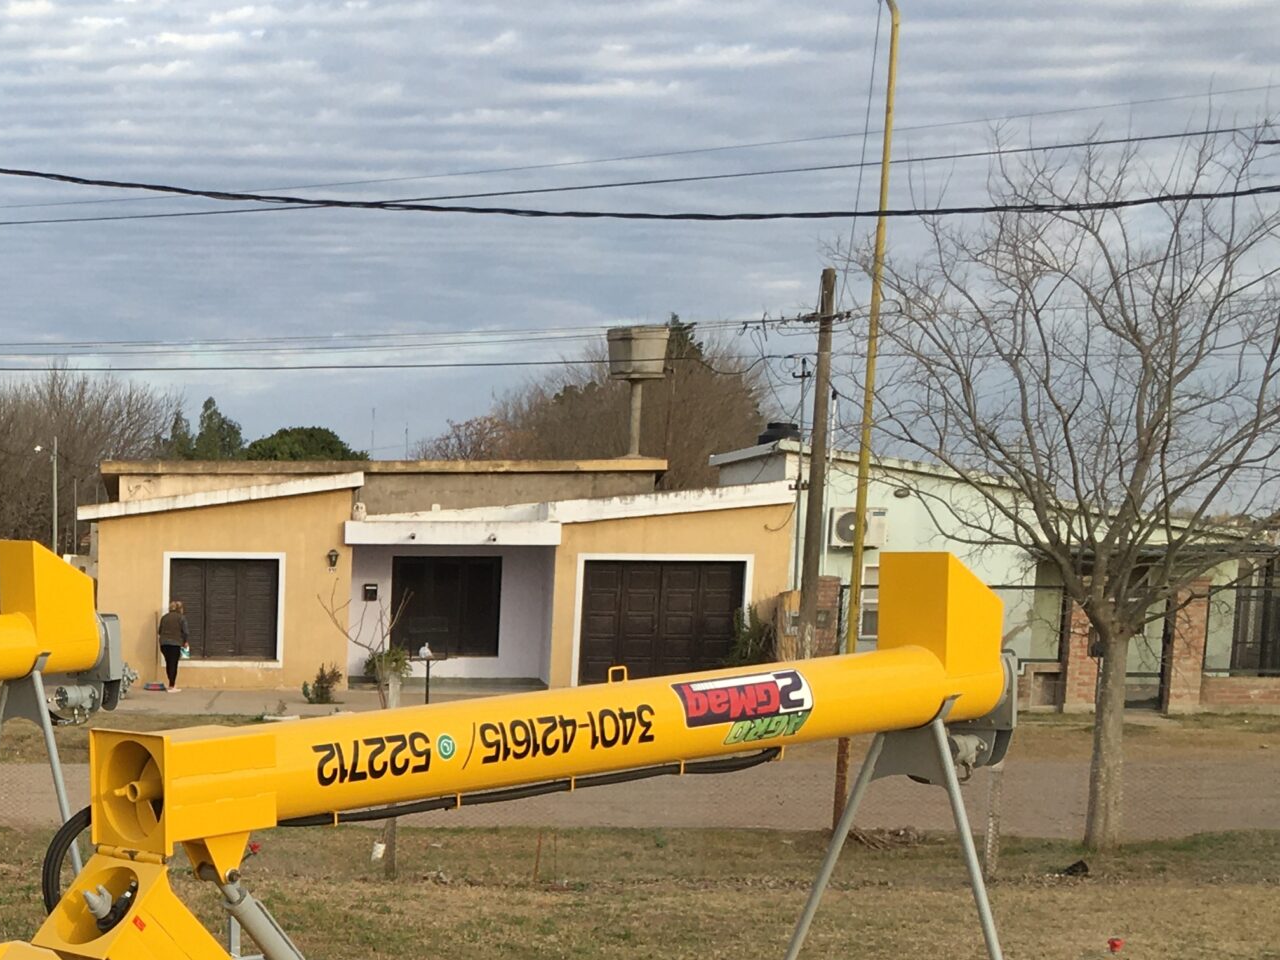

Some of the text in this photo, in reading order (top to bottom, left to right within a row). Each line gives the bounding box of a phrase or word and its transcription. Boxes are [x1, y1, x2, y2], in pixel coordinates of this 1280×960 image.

[681, 671, 805, 720] 2GMaq
[723, 711, 810, 745] AGRO
[312, 731, 431, 786] 522712
